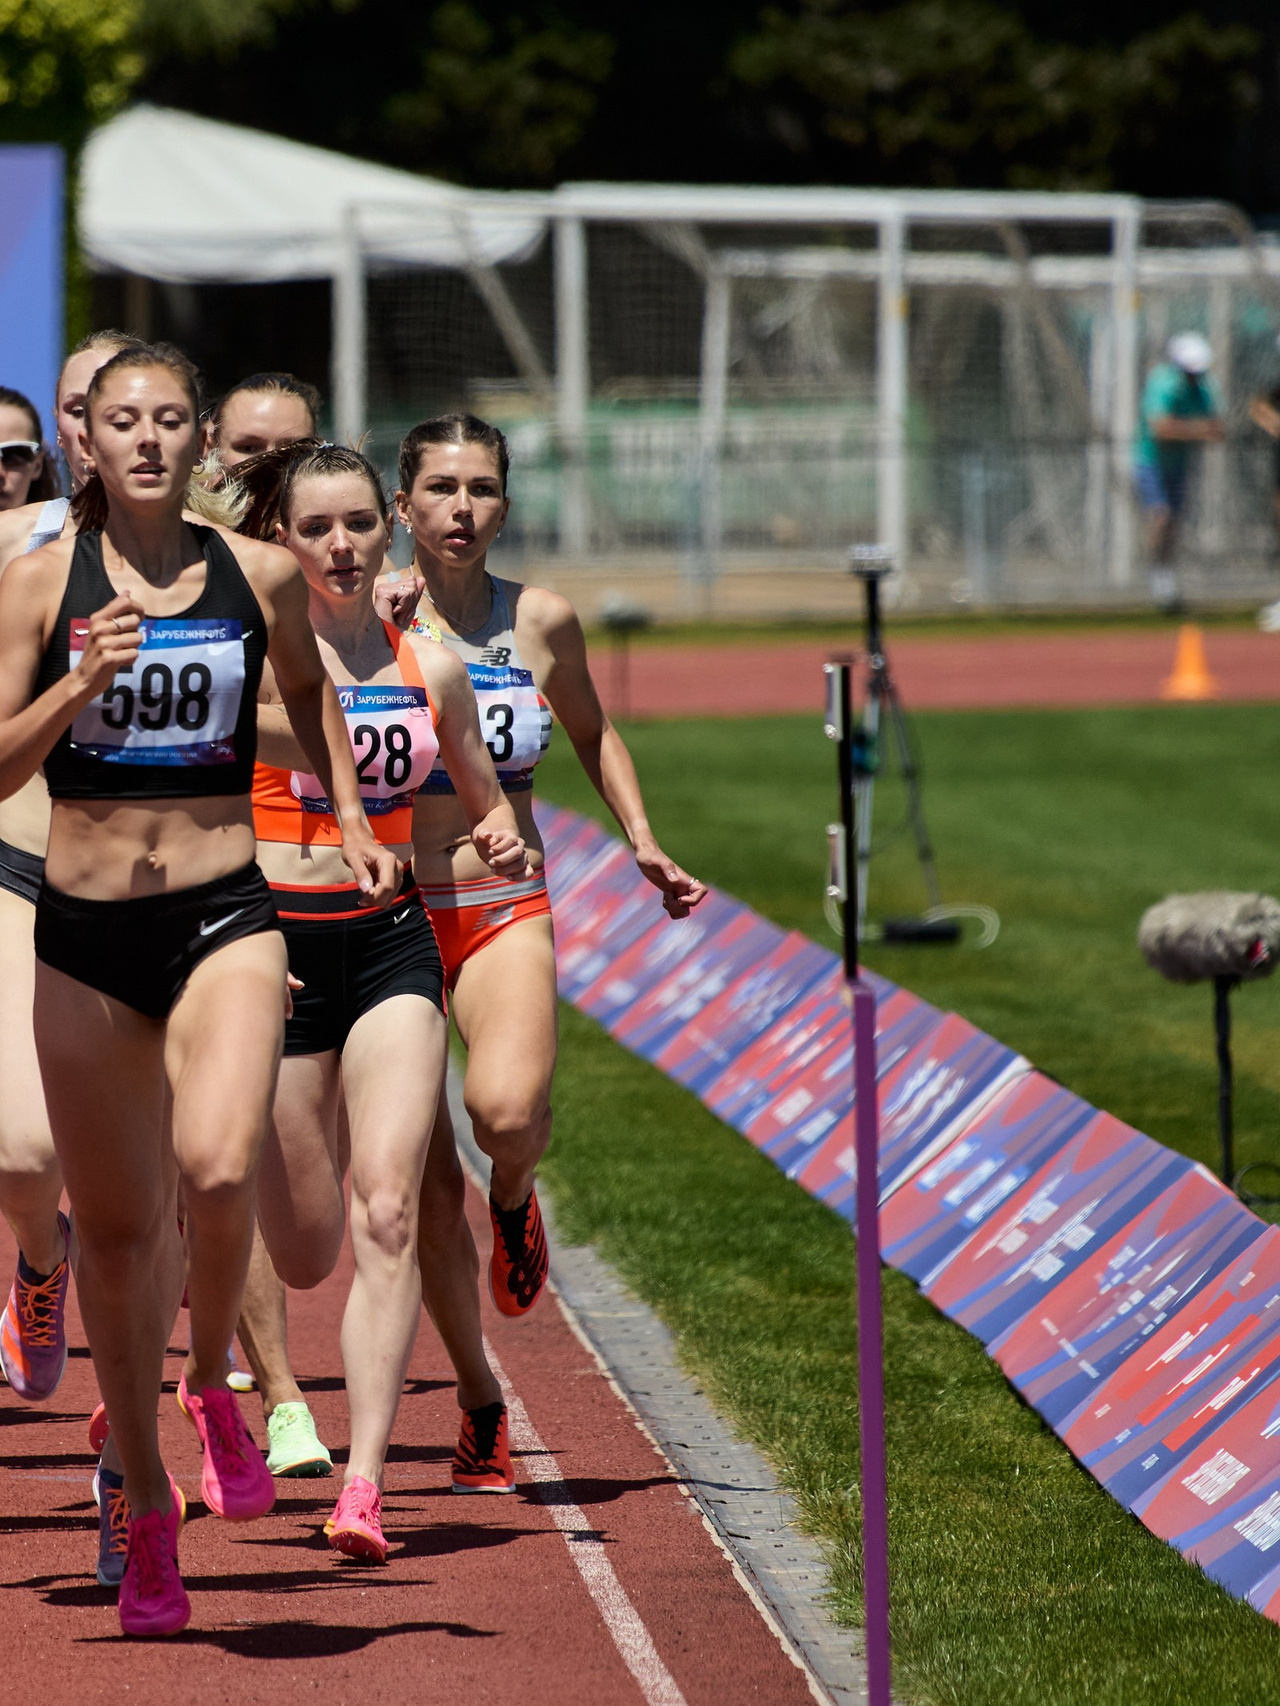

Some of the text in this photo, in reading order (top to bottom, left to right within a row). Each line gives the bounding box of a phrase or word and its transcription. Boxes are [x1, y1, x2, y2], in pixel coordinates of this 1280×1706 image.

[149, 627, 227, 640] ЗАРУБЕЖНЕФТЬ
[101, 662, 212, 731] 598
[356, 694, 418, 706] ЗАРУБЕЖНЕФТЬ
